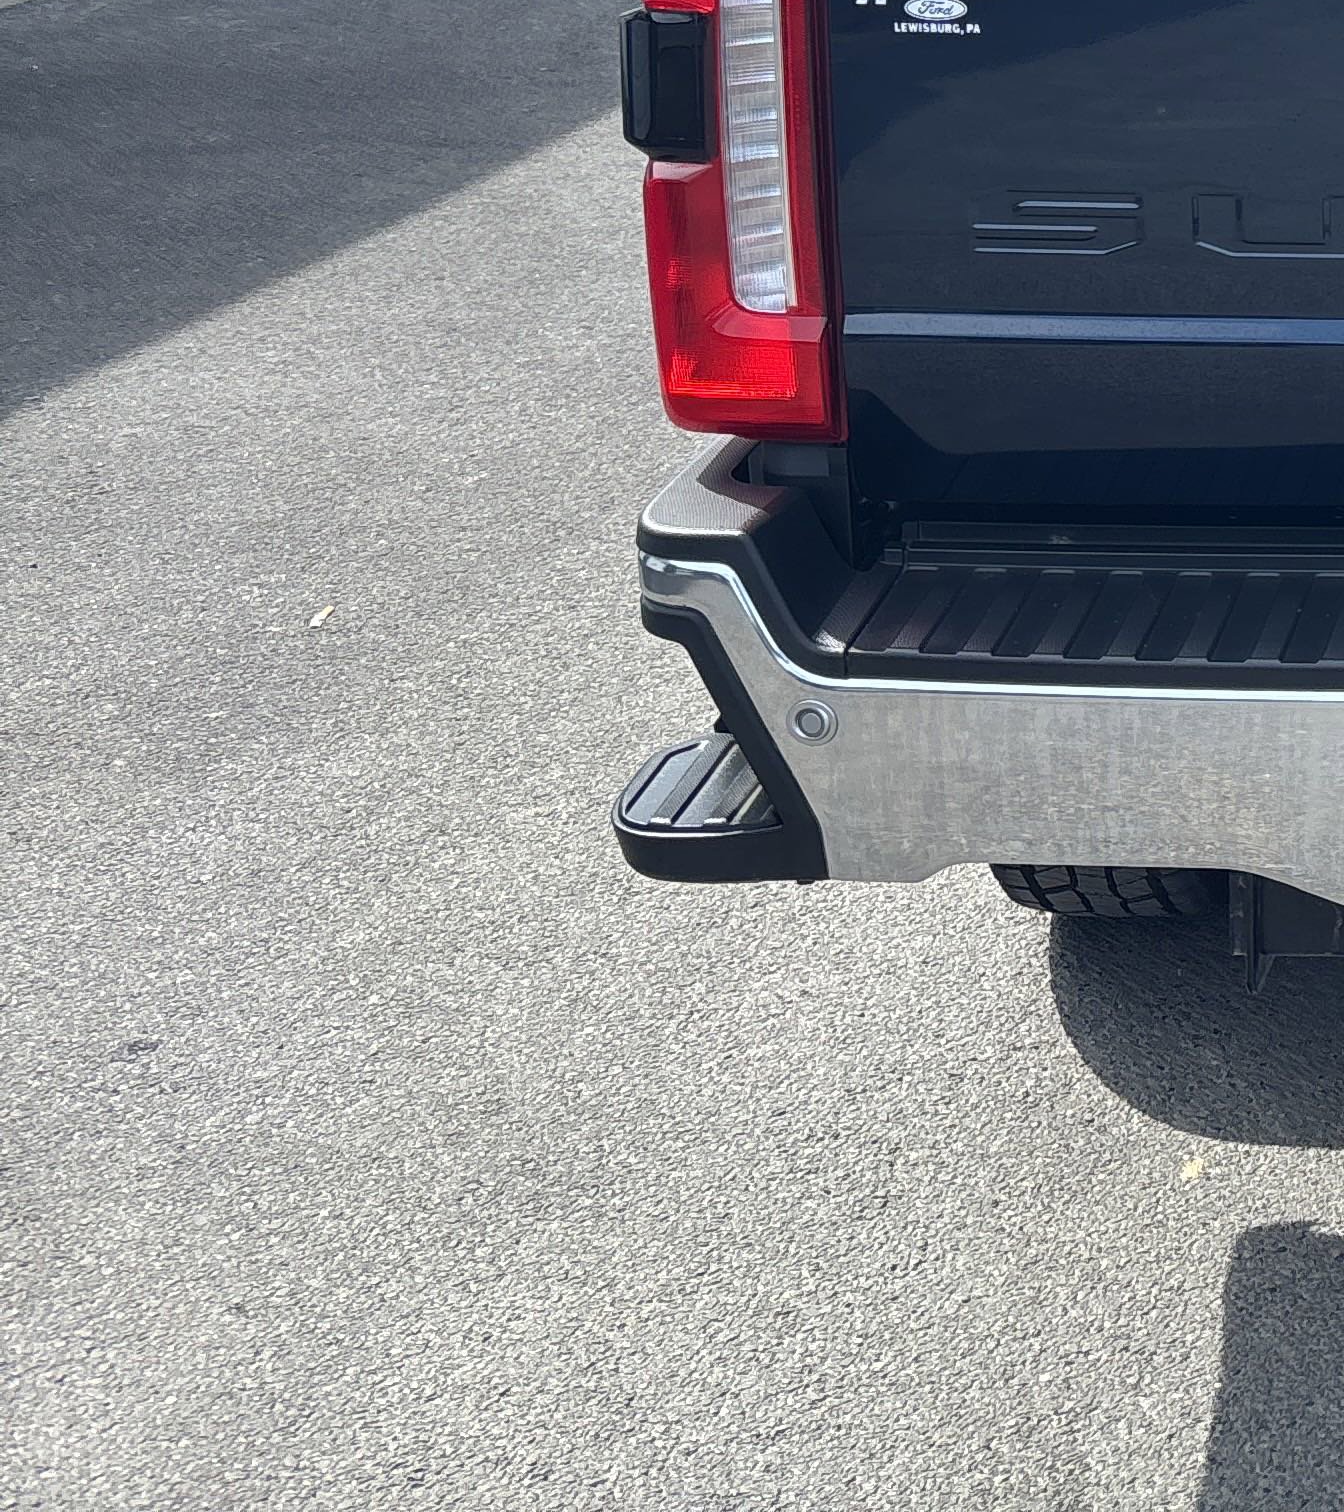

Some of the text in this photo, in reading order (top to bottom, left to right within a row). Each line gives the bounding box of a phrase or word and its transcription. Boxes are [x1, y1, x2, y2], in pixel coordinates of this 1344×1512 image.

[917, 0, 954, 16] Ford
[894, 22, 981, 36] LEWISBURG, PA
